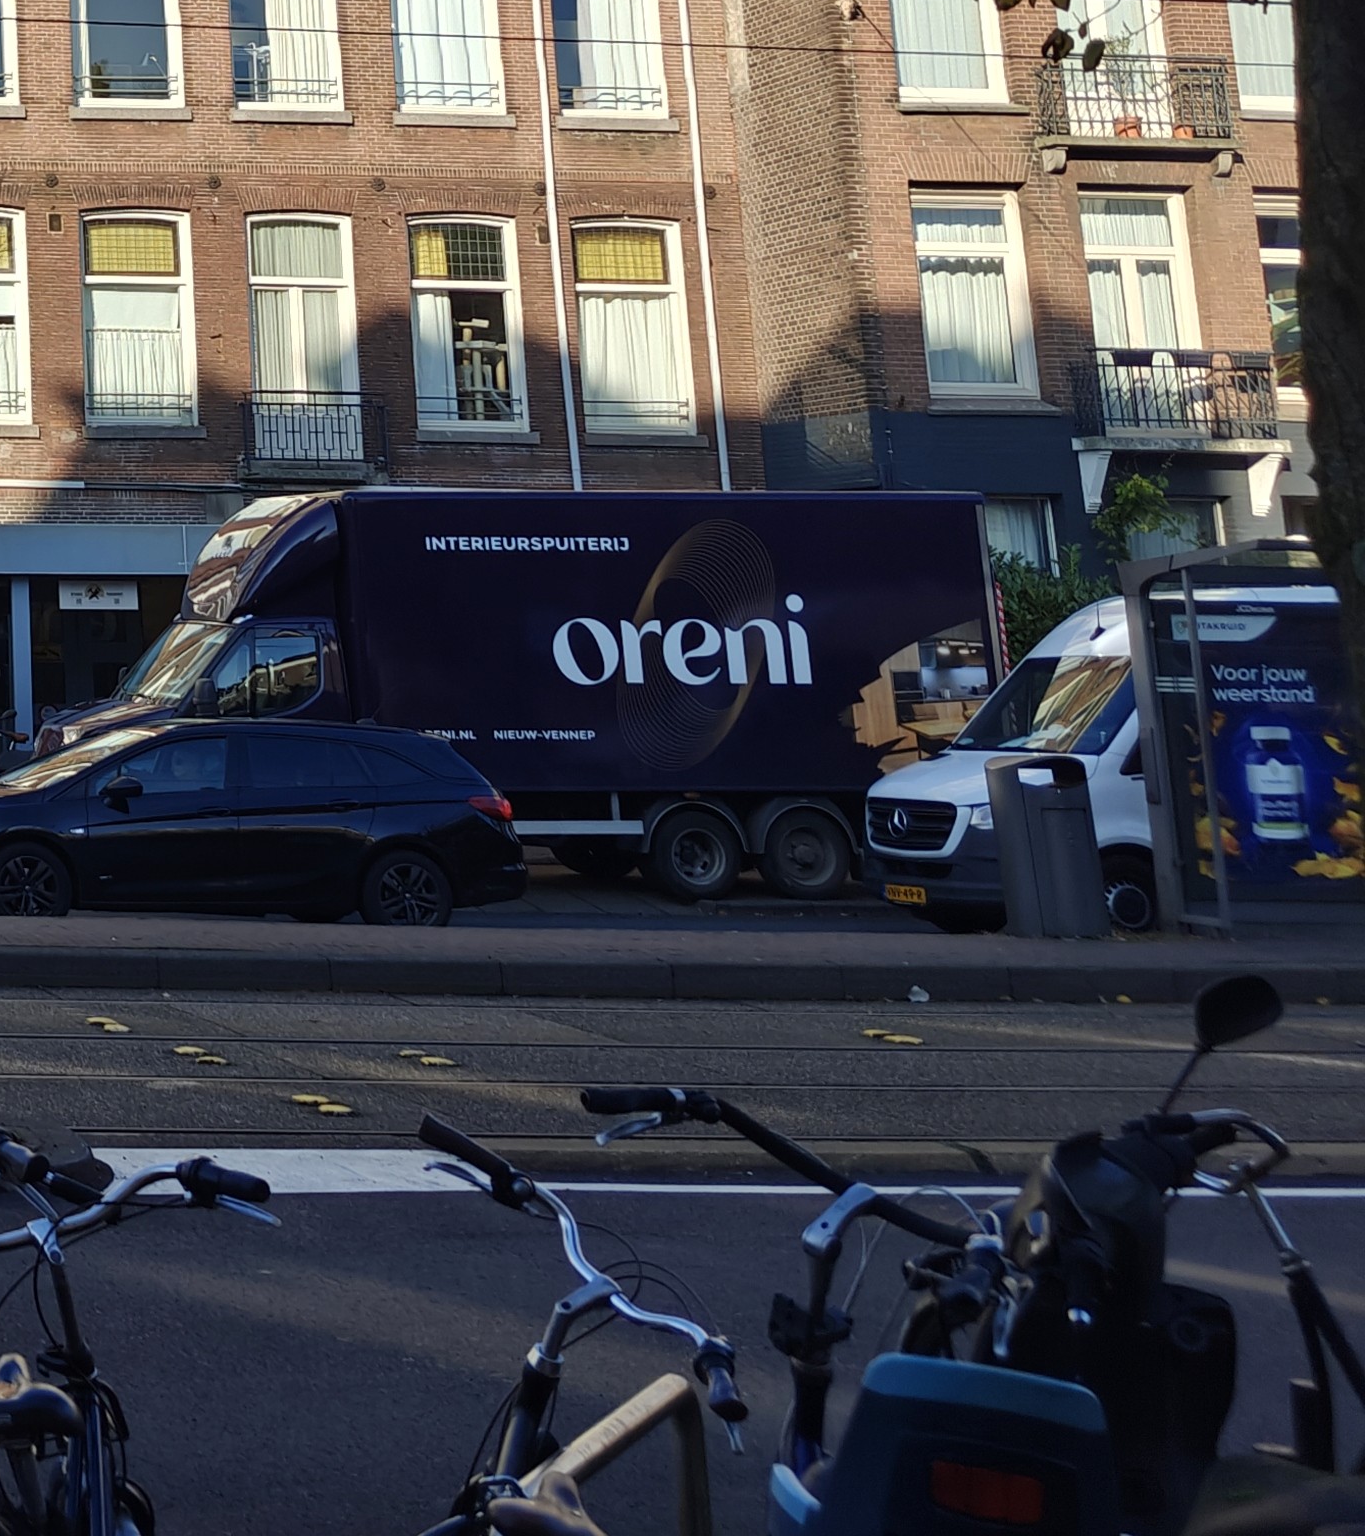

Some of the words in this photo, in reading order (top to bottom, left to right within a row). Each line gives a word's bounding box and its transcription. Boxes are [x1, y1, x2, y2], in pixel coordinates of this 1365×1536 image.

[425, 536, 630, 551] INTERIEURSPUITERIJ
[552, 594, 813, 686] oreni
[1210, 664, 1259, 681] Voor
[1261, 664, 1307, 685] jouw
[1212, 685, 1316, 703] weerstand
[494, 729, 596, 740] NIEUW-VENNEP
